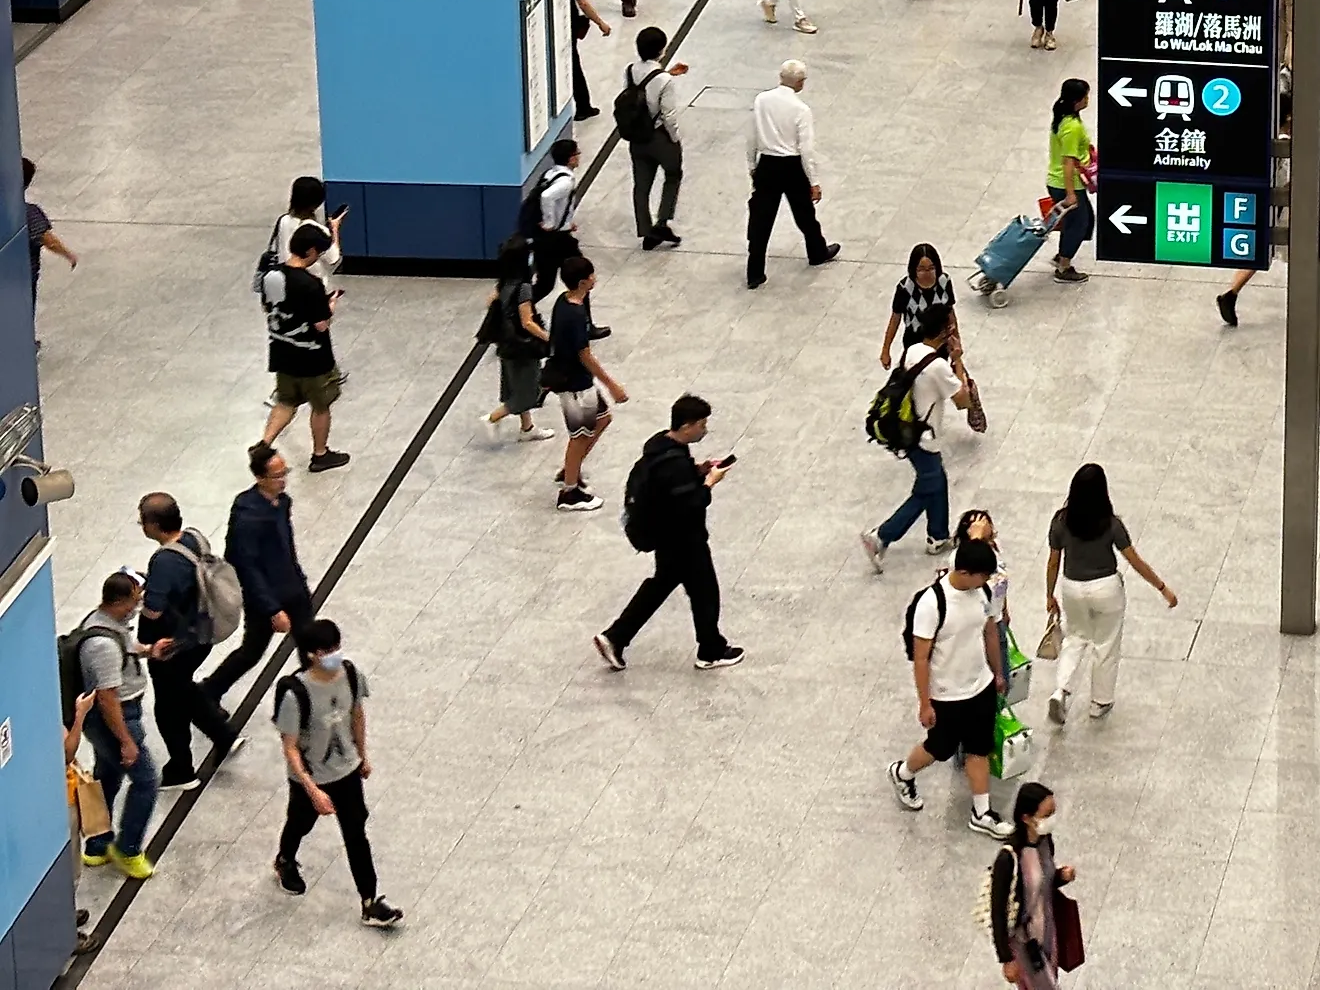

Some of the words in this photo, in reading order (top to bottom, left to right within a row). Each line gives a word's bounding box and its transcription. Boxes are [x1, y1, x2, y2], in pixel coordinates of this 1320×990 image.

[1154, 11, 1262, 41] 羅湖/落馬洲
[1154, 38, 1168, 50] Lo
[1170, 39, 1213, 52] Wu/Lok
[1215, 41, 1232, 53] Ma
[1234, 42, 1263, 55] Chau
[1212, 84, 1231, 109] 2
[1154, 128, 1207, 154] 金鐘
[1152, 153, 1212, 170] Admiralty
[1233, 197, 1248, 219] F
[1166, 231, 1200, 243] EXIT
[1230, 234, 1249, 258] G
